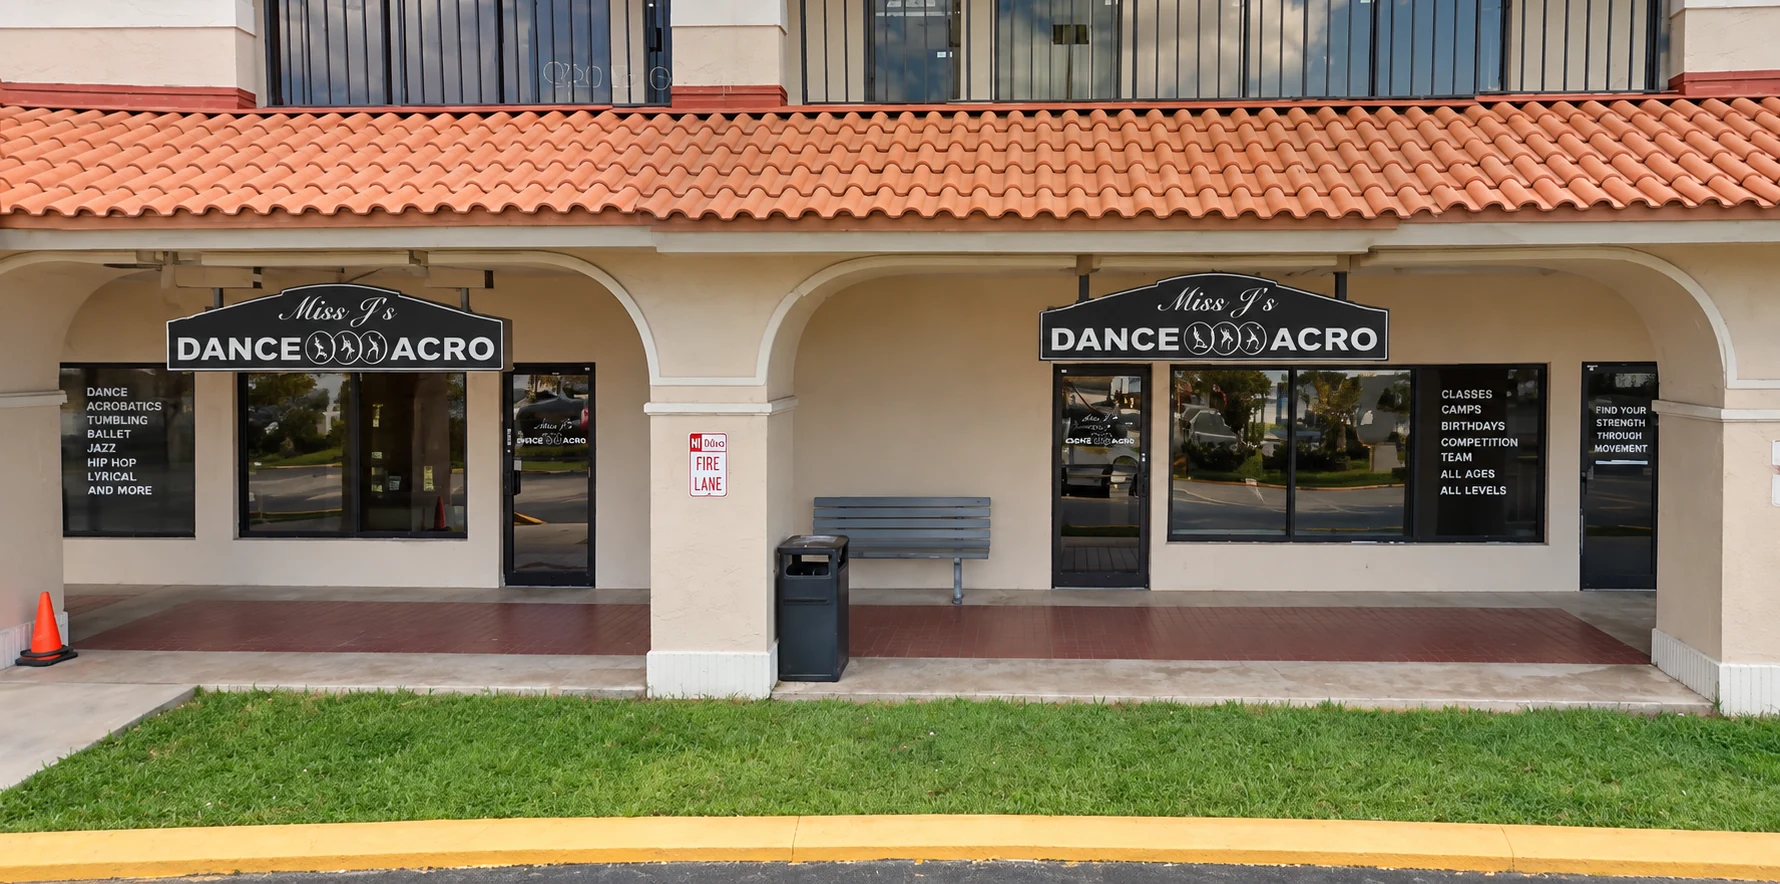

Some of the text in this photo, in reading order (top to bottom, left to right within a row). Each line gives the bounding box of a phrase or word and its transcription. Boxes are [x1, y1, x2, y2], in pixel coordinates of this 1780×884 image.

[1157, 286, 1279, 319] Miss J's
[278, 295, 398, 328] Miss J's
[1052, 327, 1378, 352] DANCE ACRO
[178, 336, 495, 361] DANCE ACRO
[88, 387, 128, 397] DANCE
[1442, 389, 1493, 399] CLASSES
[87, 401, 162, 411] ACROBATICS
[1442, 404, 1482, 415] CAMPS
[1596, 406, 1647, 415] FIND YOUR
[87, 415, 148, 425] TUMBLING
[1597, 418, 1646, 427] STRENGTH
[1442, 421, 1506, 431] BIRTHDAYS
[88, 429, 132, 439] BALLET
[1598, 431, 1642, 440] THROUGH
[1441, 437, 1518, 447] COMPETITION
[87, 443, 116, 453] JAZZ
[1595, 444, 1649, 453] MOVEMENT
[1441, 452, 1472, 462] TEAM
[88, 457, 137, 468] HIP HOP
[696, 456, 720, 471] FIRE
[88, 471, 137, 482] LYRICAL
[1441, 469, 1496, 479] ALL AGES
[694, 476, 722, 491] LANE
[88, 485, 153, 496] AND MORE
[1441, 485, 1507, 496] ALL LEVELS
